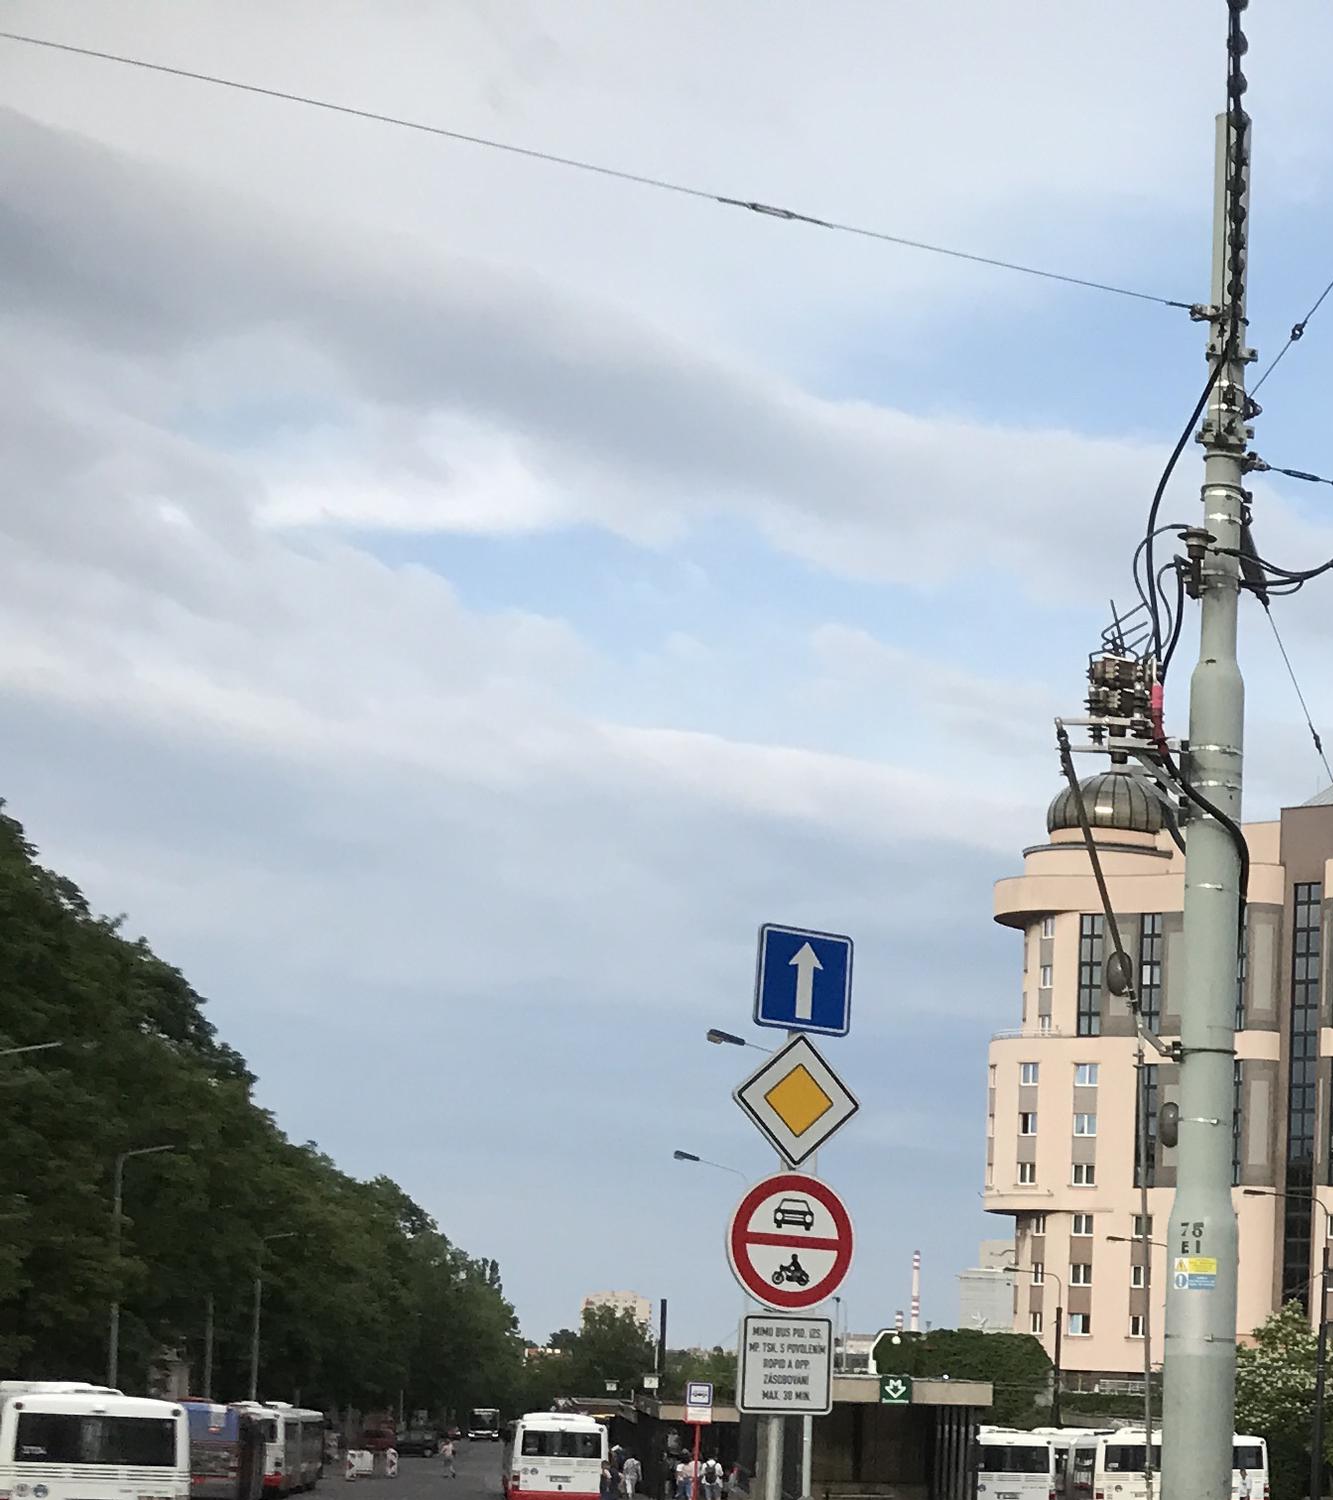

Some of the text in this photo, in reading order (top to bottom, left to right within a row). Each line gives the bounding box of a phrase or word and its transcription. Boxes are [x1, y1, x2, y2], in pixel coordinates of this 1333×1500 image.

[775, 1327, 790, 1337] BUS
[780, 1343, 785, 1353] S
[787, 1359, 793, 1368] A
